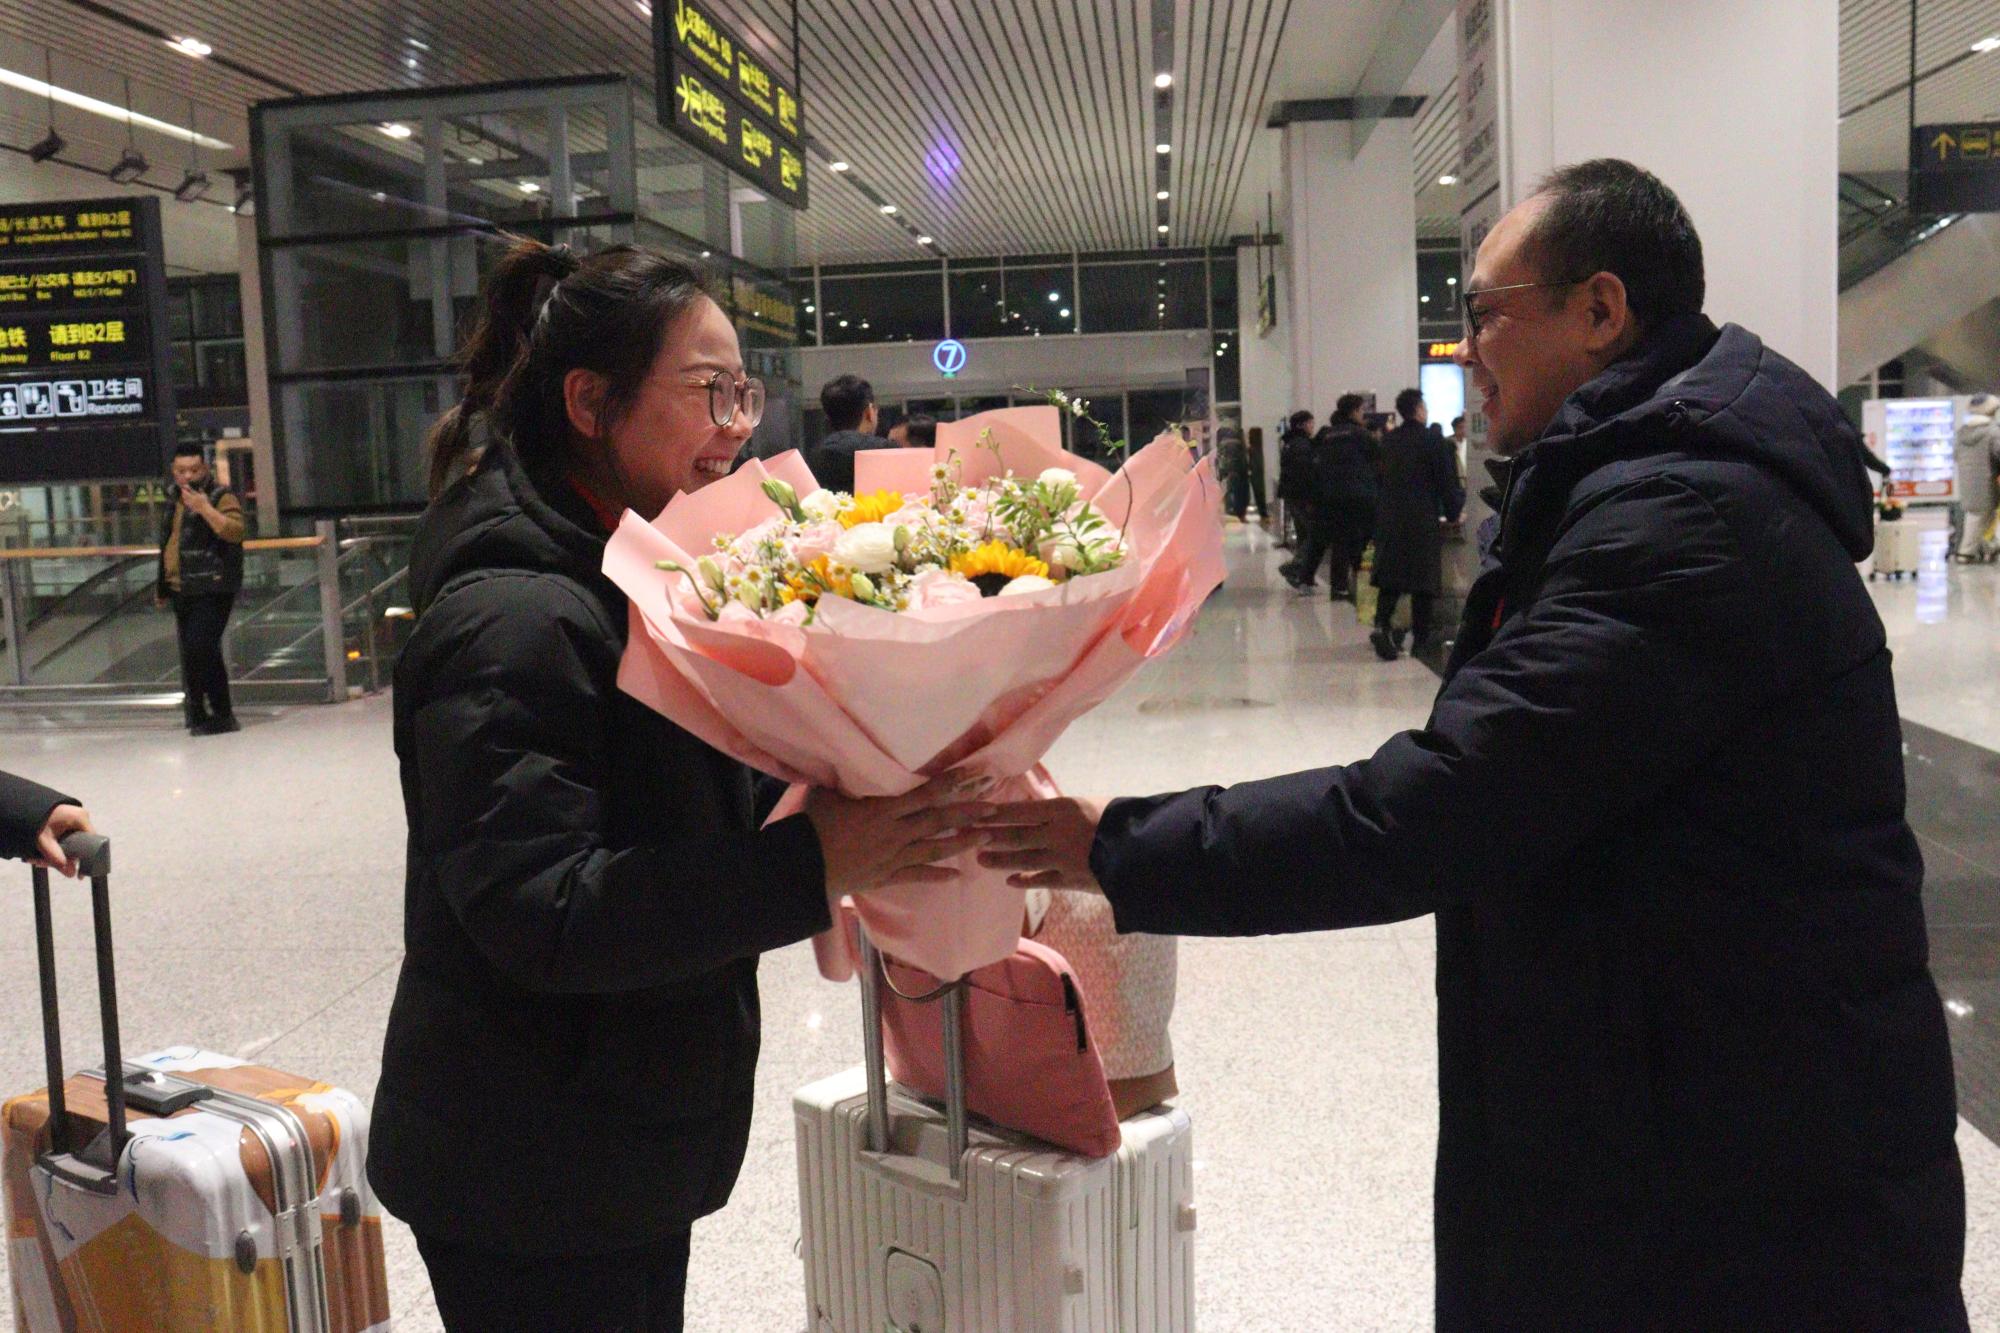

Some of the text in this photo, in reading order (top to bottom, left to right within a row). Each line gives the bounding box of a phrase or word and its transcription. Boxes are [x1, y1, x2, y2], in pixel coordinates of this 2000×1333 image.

[49, 321, 125, 345] 请到B2层
[88, 378, 143, 399] 卫生间
[88, 403, 142, 414] Restroom
